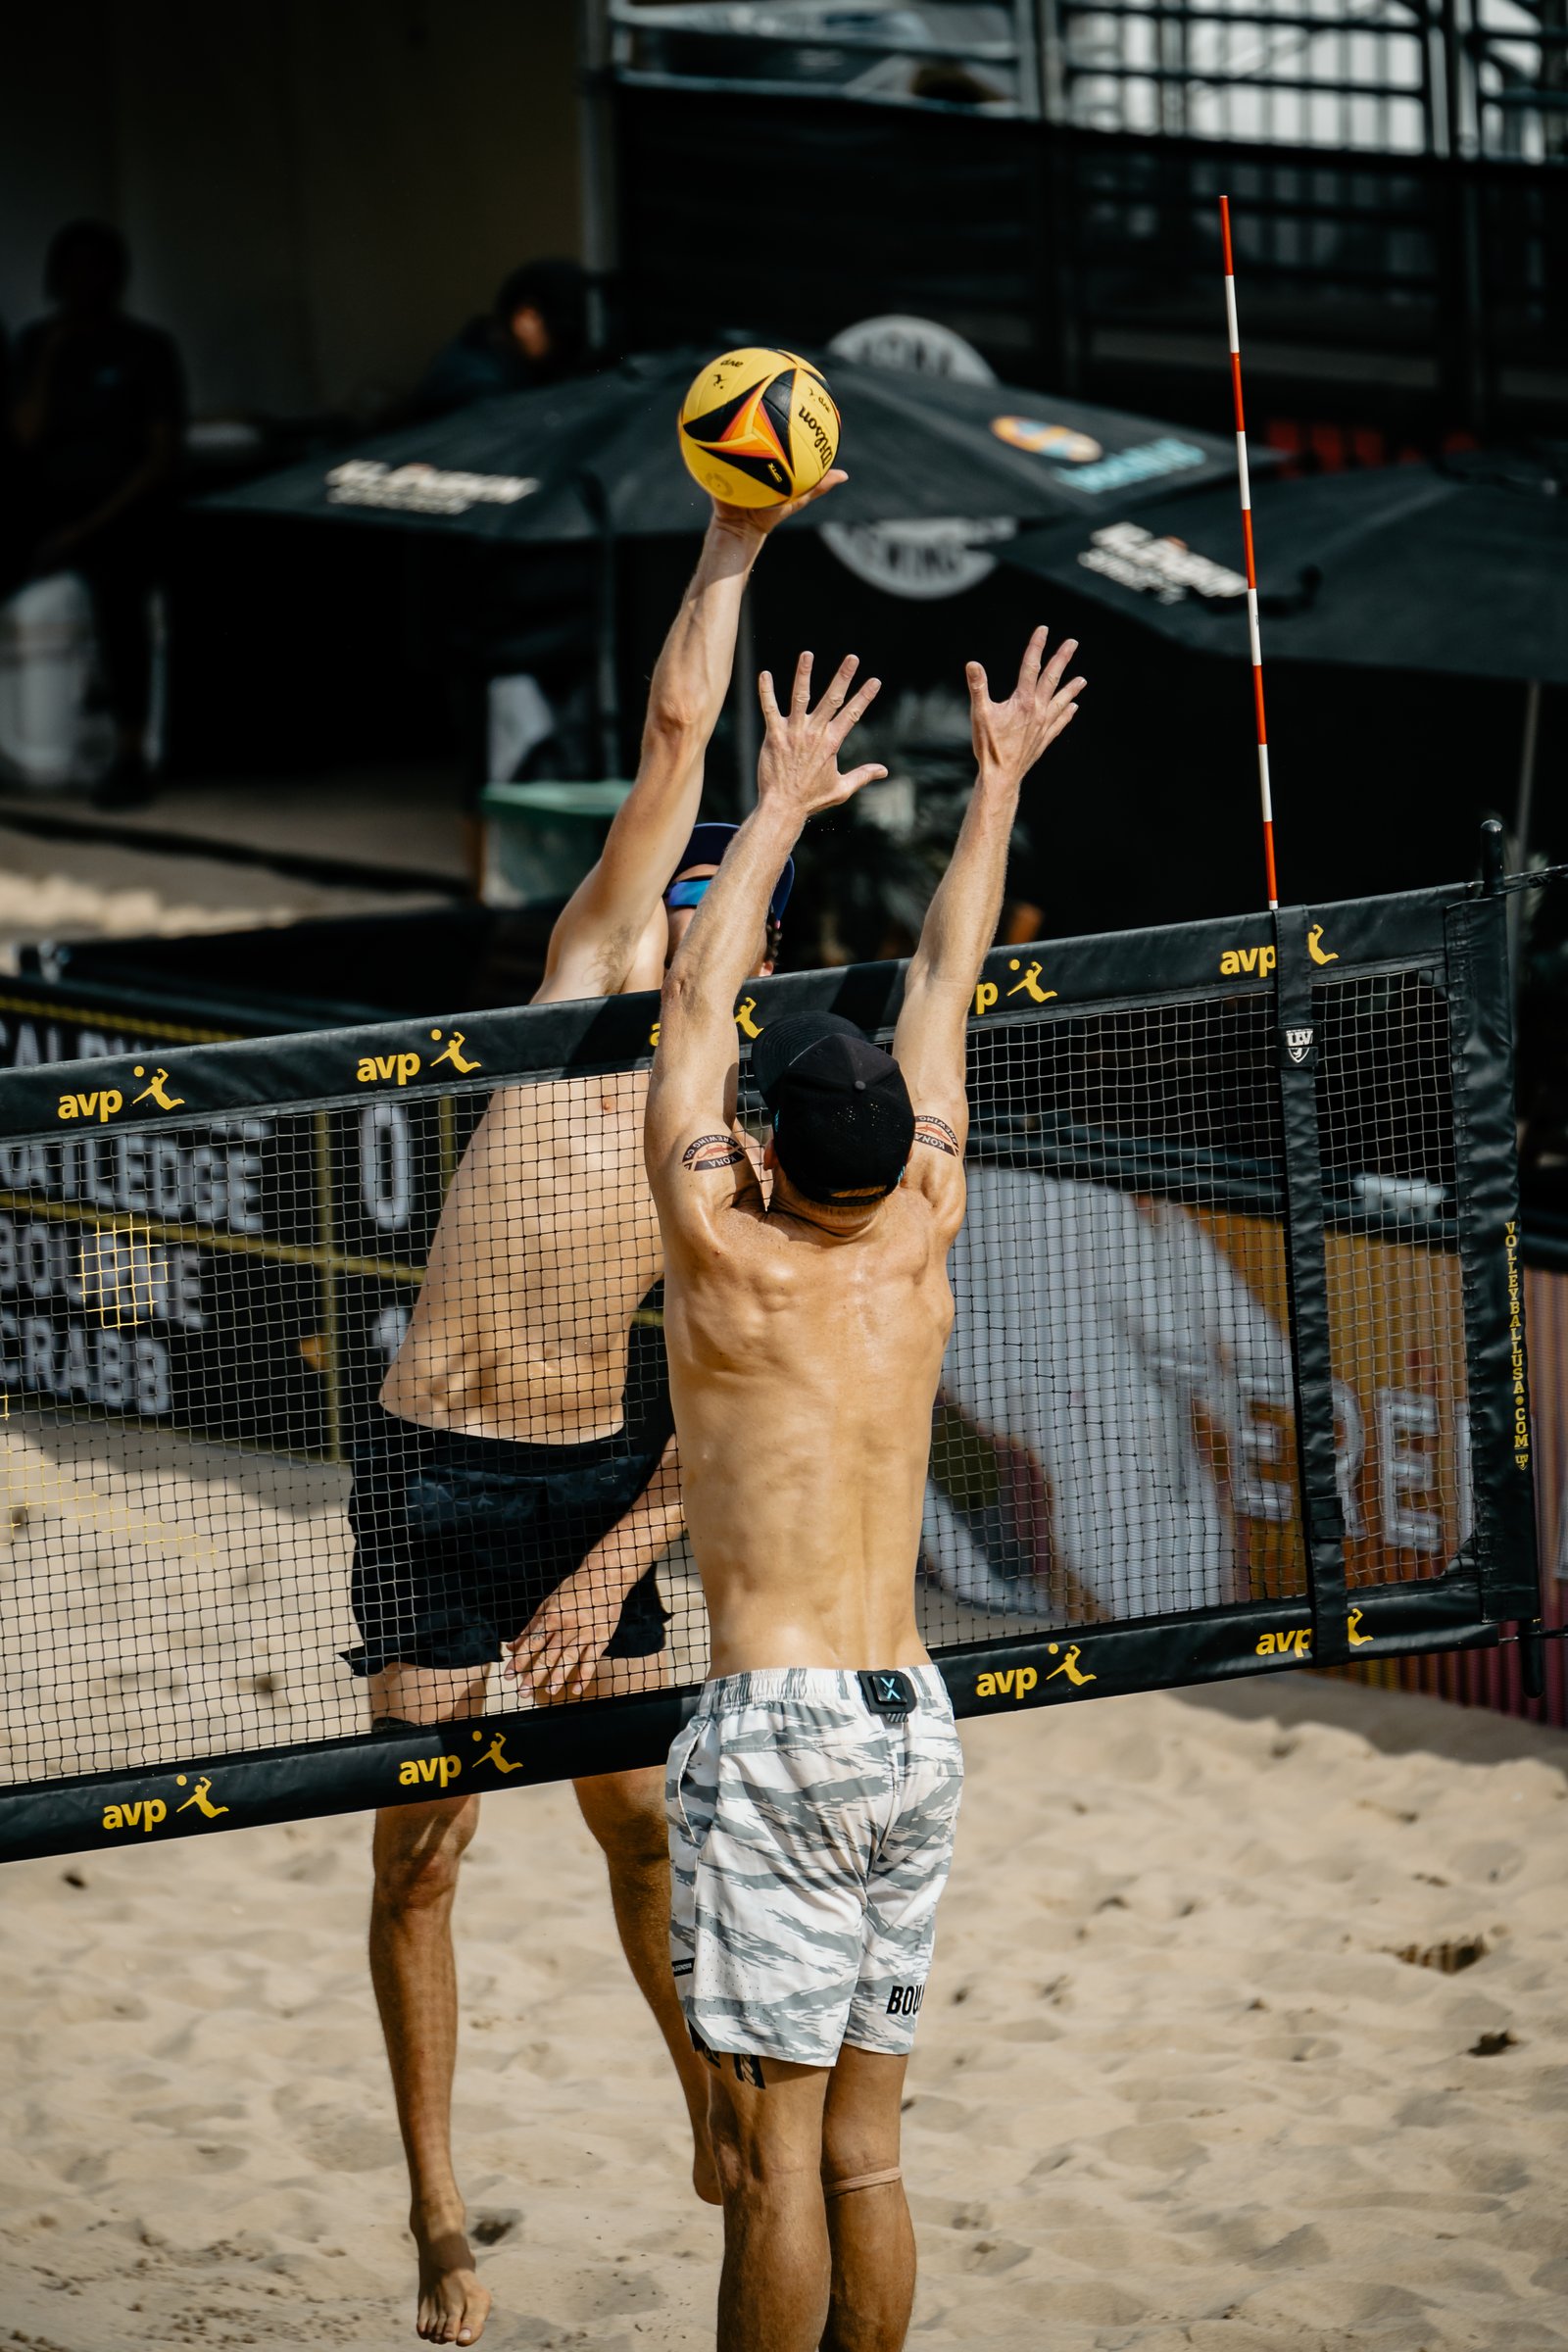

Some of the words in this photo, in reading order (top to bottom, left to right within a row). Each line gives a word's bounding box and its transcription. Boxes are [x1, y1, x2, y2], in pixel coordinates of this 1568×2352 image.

[799, 404, 833, 469] Wilson
[1220, 946, 1276, 978] avp
[356, 1052, 421, 1086] avp
[57, 1089, 123, 1123] avp
[708, 1155, 737, 1168] KONA
[1255, 1628, 1312, 1658] avp
[976, 1667, 1038, 1699] avp
[398, 1750, 462, 1788] avp
[102, 1797, 167, 1832] avp
[886, 1984, 925, 2016] BOU
